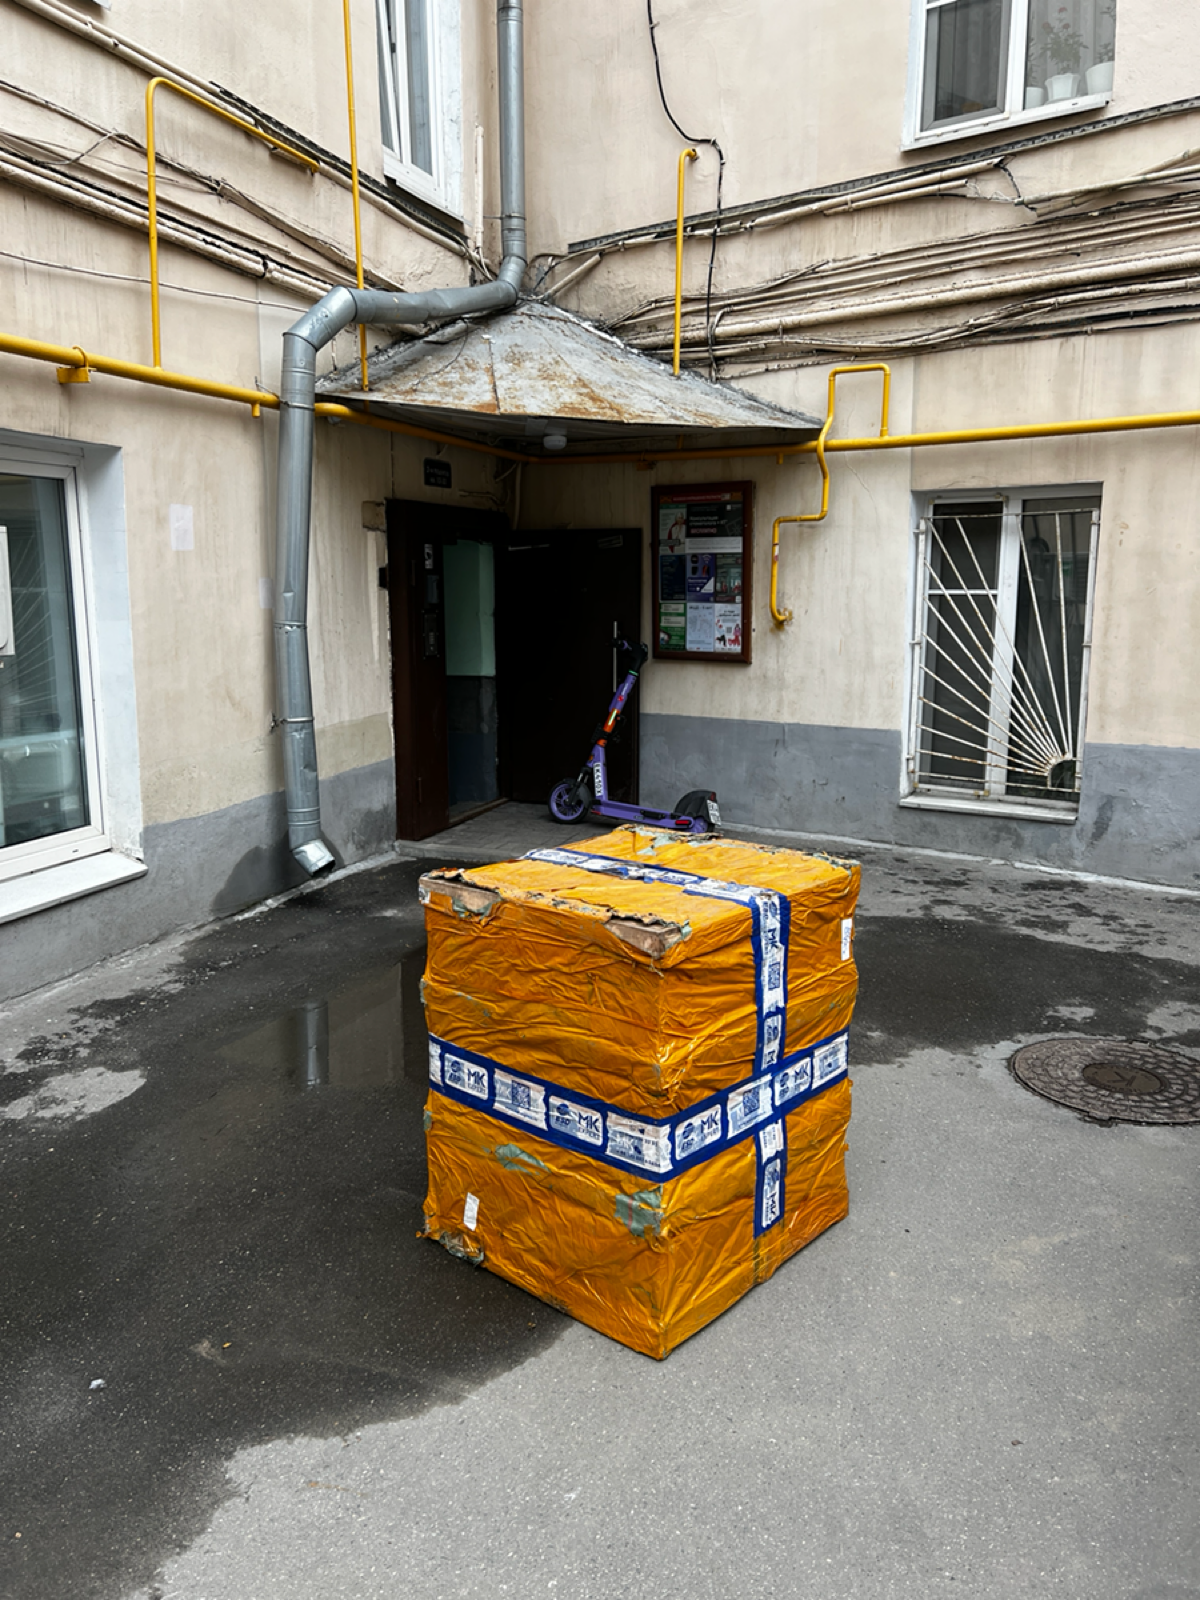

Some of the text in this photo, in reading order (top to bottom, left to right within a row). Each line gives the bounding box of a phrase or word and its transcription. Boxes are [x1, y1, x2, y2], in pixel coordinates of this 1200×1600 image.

[467, 1067, 486, 1088] MK
[578, 1111, 600, 1133] MK
[700, 1110, 719, 1133] MK
